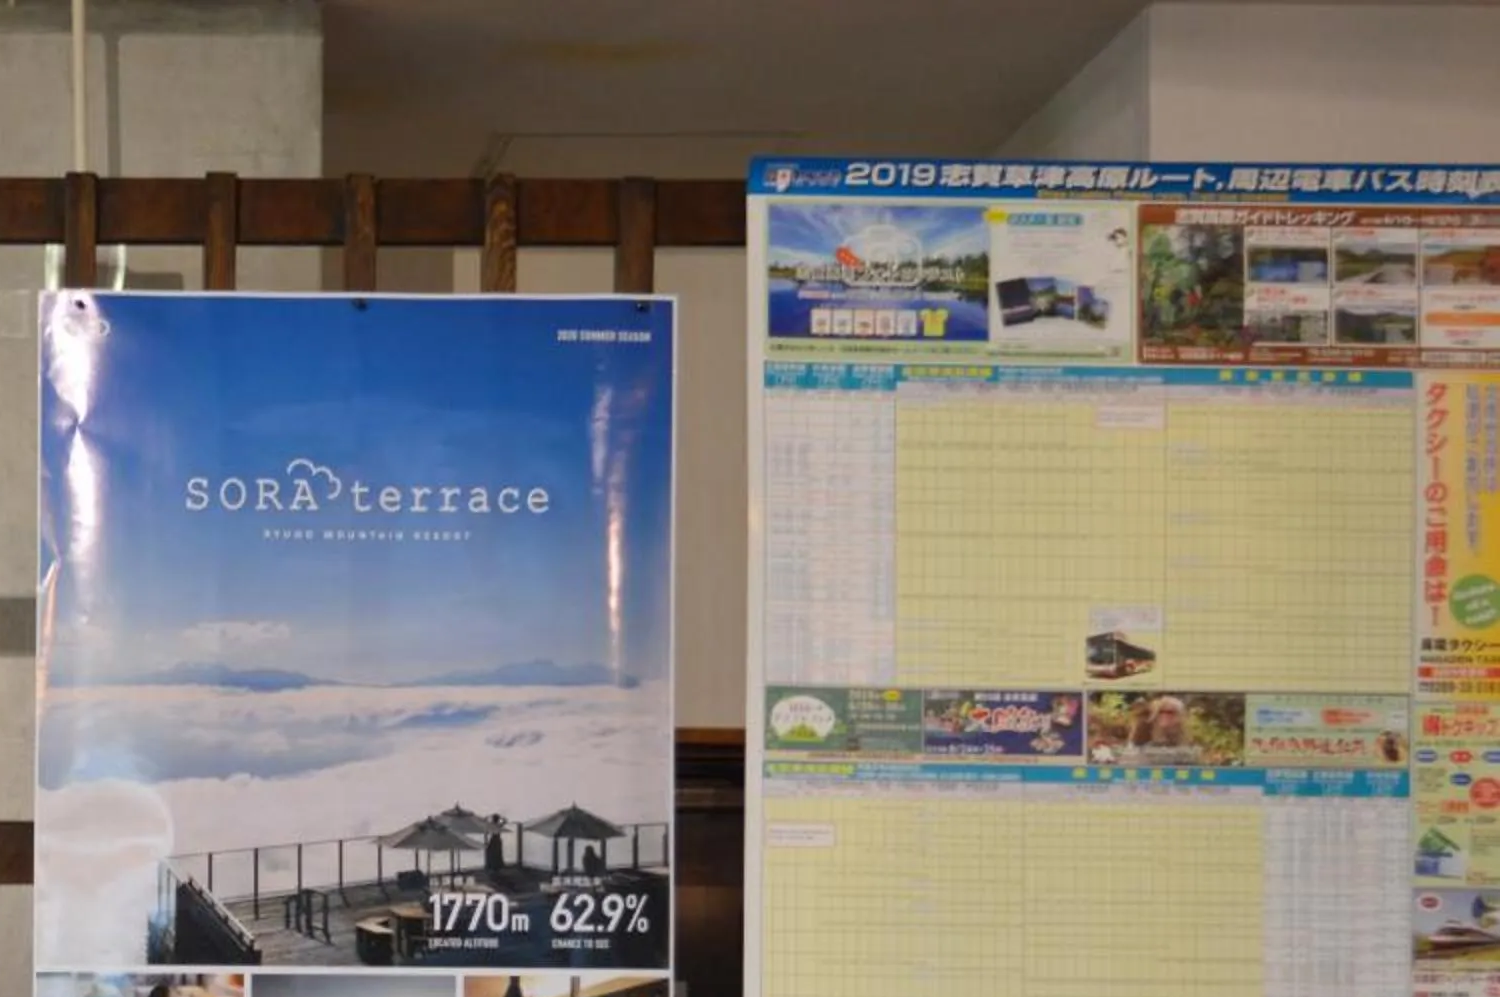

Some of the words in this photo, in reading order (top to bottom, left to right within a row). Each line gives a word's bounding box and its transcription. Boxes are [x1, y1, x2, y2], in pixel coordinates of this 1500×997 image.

[844, 162, 935, 187] 2019
[185, 478, 319, 511] SORA
[350, 480, 550, 513] terrace
[550, 893, 650, 933] 62.9%
